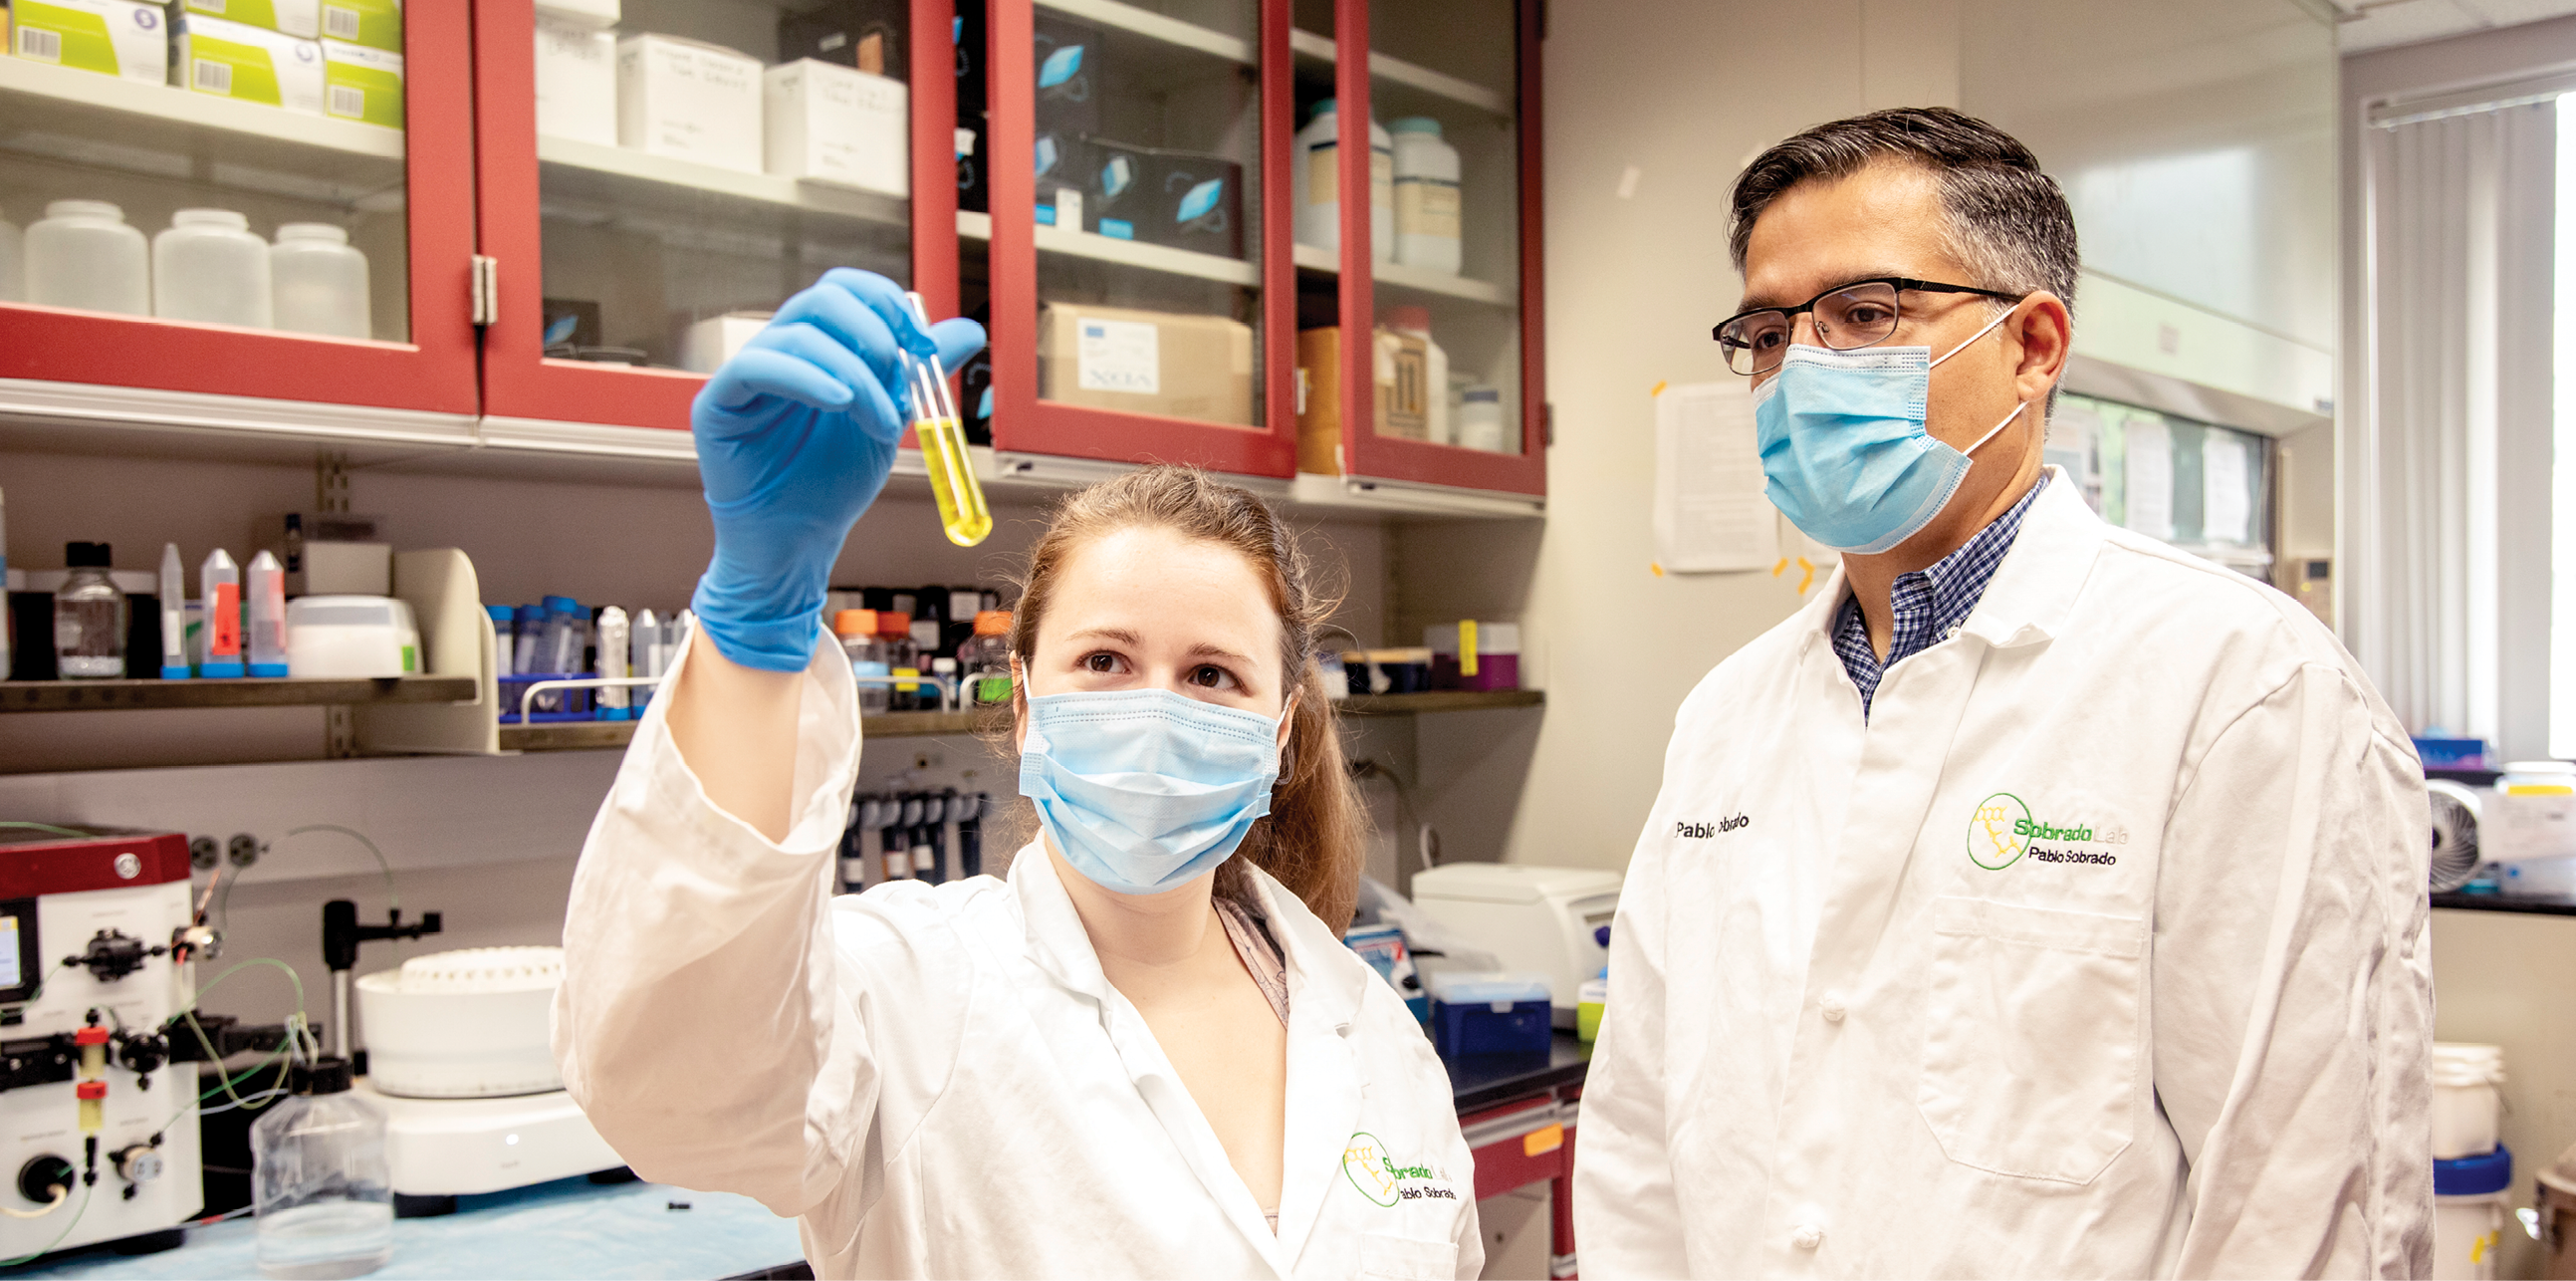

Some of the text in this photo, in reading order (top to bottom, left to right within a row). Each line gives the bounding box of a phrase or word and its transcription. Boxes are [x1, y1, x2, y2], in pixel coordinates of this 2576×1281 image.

[2013, 818, 2130, 845] Sobrado Lab
[2028, 847, 2117, 866] Pablo Sobrado
[1382, 1156, 1433, 1179] Sbrado
[1400, 1187, 1422, 1199] ablo
